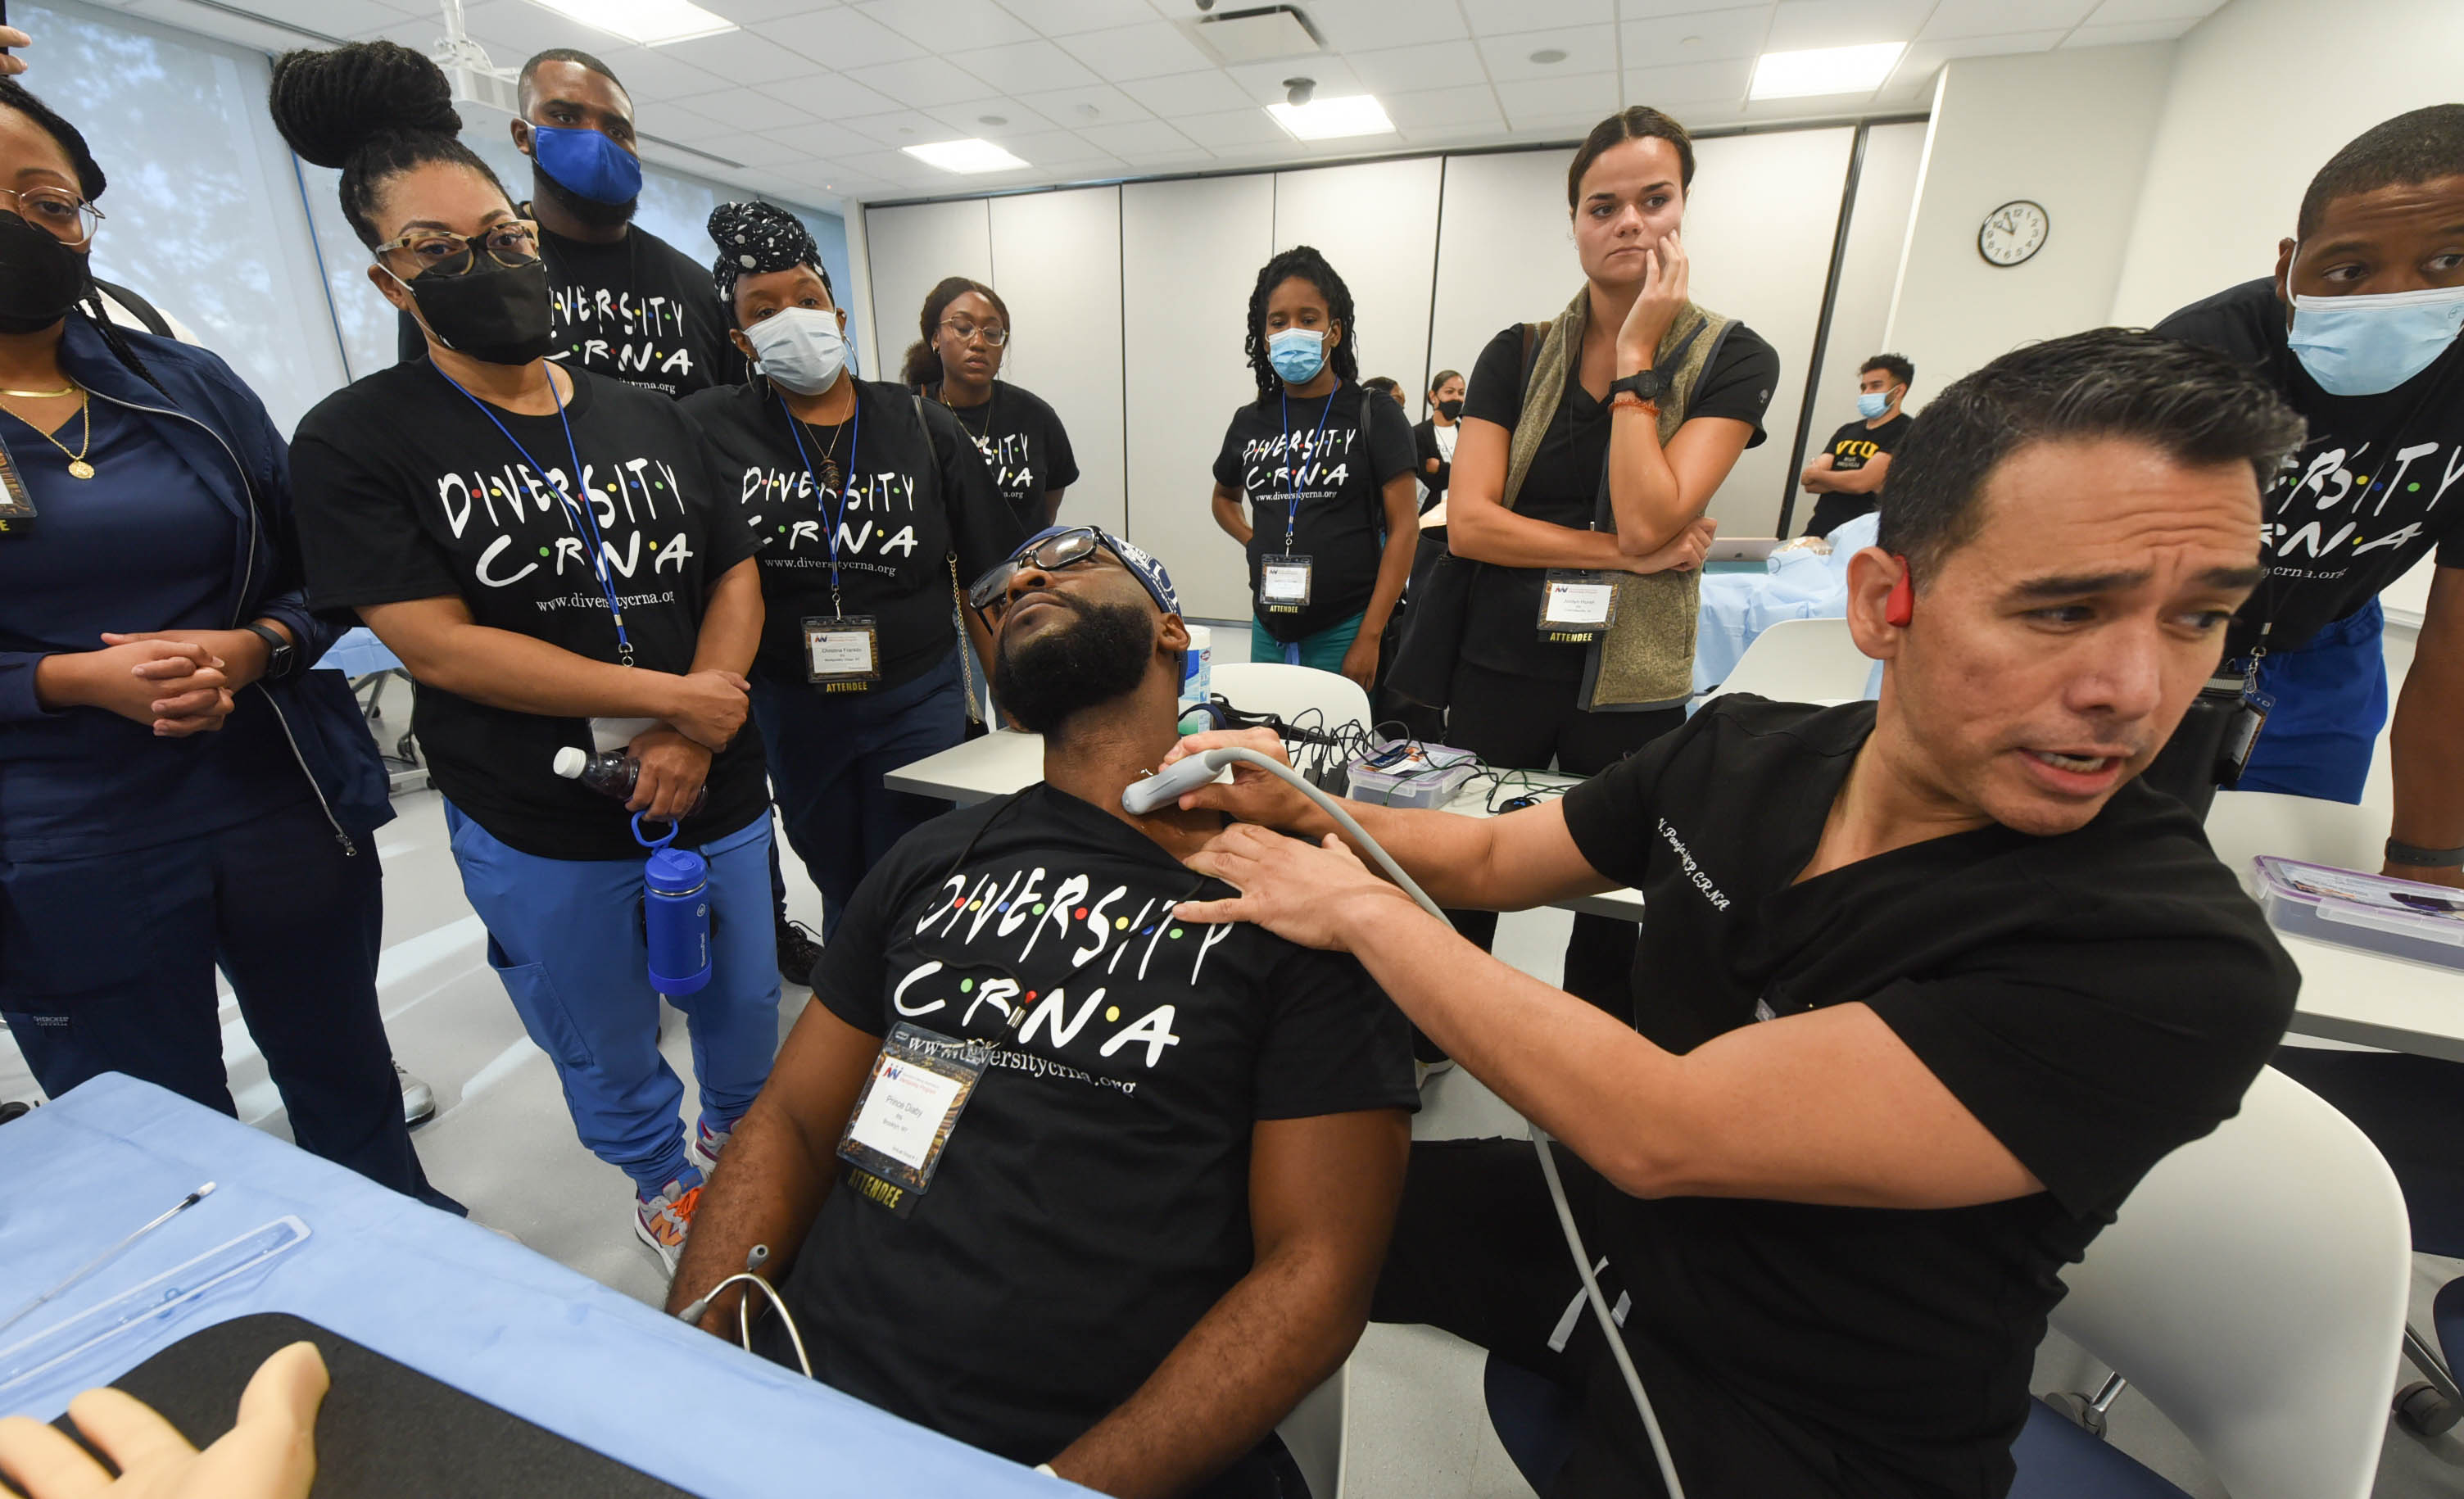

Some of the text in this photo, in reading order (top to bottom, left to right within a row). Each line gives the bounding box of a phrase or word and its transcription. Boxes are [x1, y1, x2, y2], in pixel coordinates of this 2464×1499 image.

[550, 286, 684, 337] IVERSITY
[1836, 440, 1879, 460] VCU
[764, 556, 896, 577] www.diverstycrna.org
[1270, 605, 1298, 614] ATTENDEE
[1550, 632, 1593, 642] ATTENDEE
[826, 681, 868, 694] ATTENDEE
[847, 1168, 904, 1209] ATTENDEE
